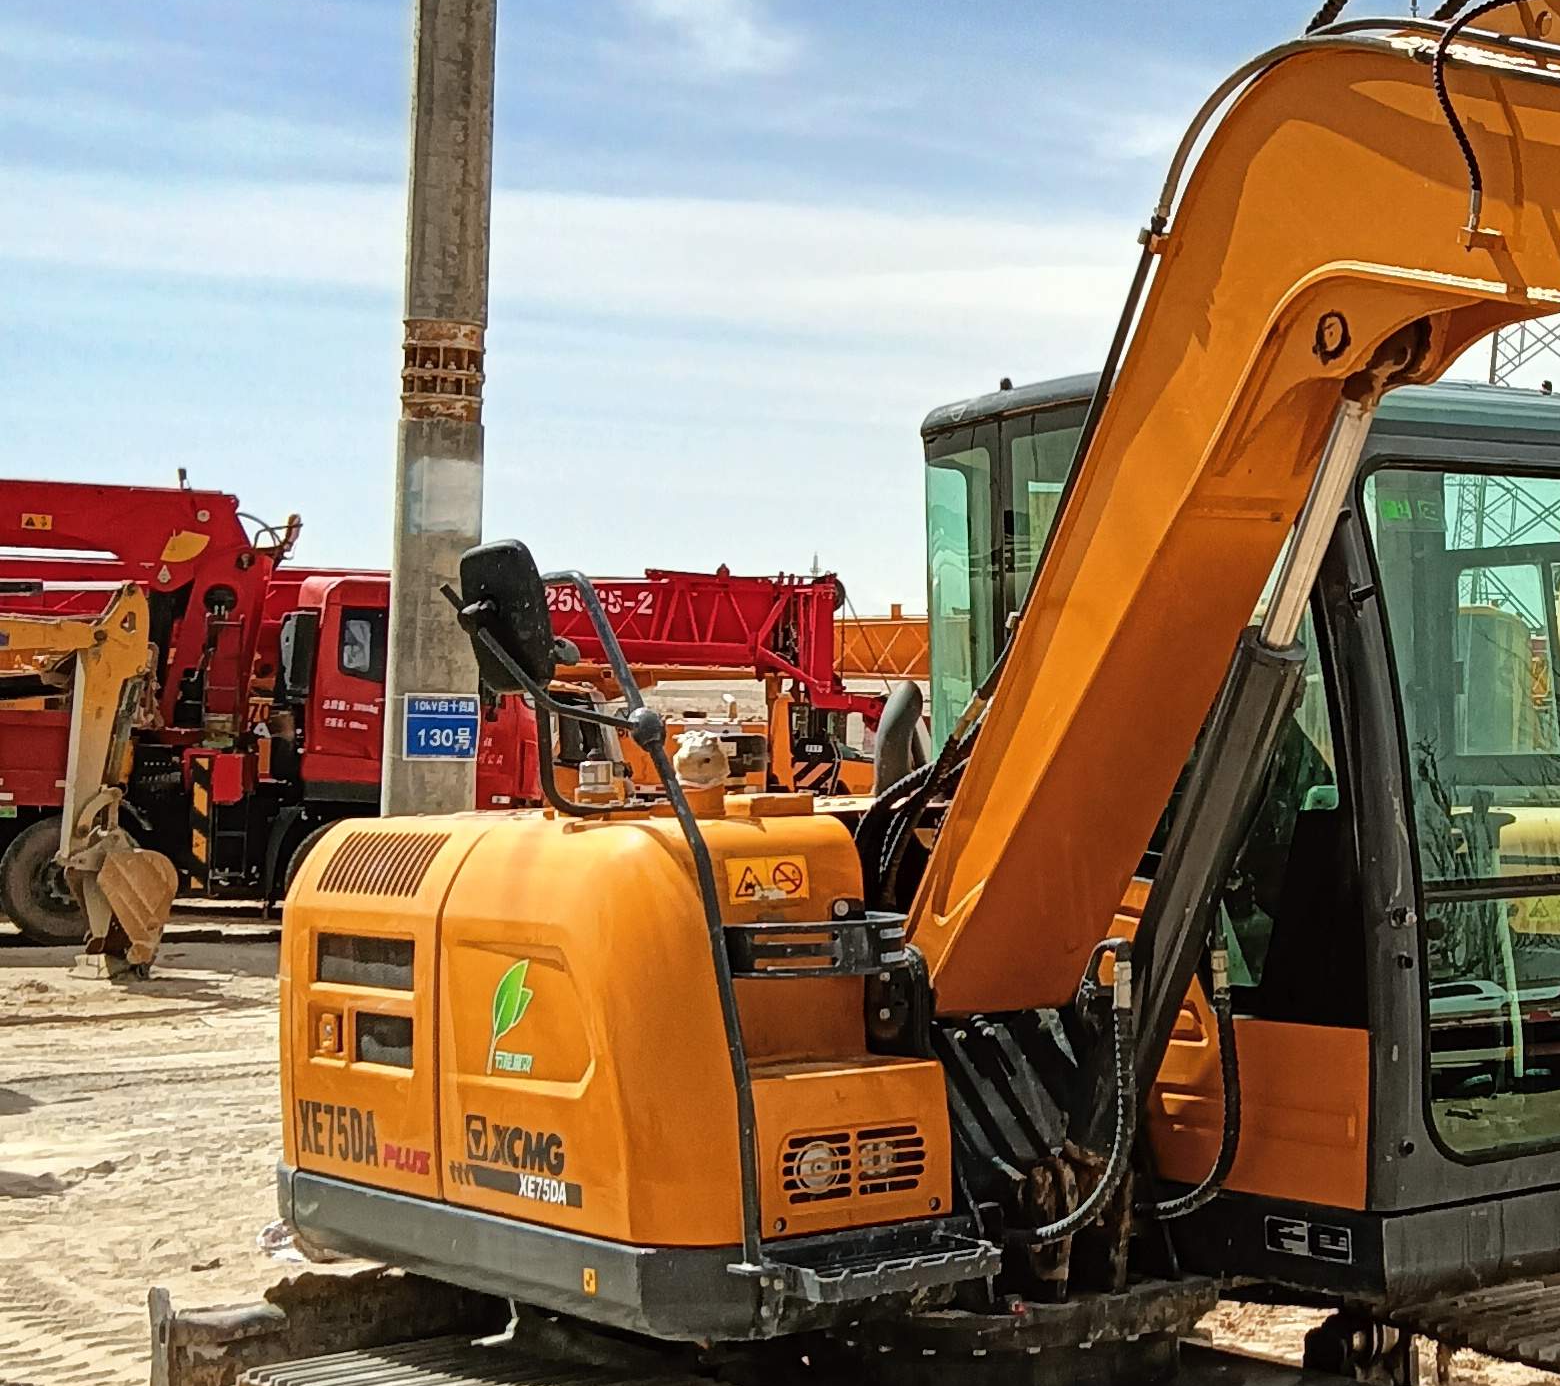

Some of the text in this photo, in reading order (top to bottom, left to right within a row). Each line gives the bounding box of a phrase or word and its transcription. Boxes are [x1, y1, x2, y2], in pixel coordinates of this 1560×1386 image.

[417, 727, 472, 750] 130号
[298, 1098, 431, 1175] XE75DA PLUS
[489, 1123, 565, 1176] XCMG
[518, 1173, 567, 1206] XE75DA
